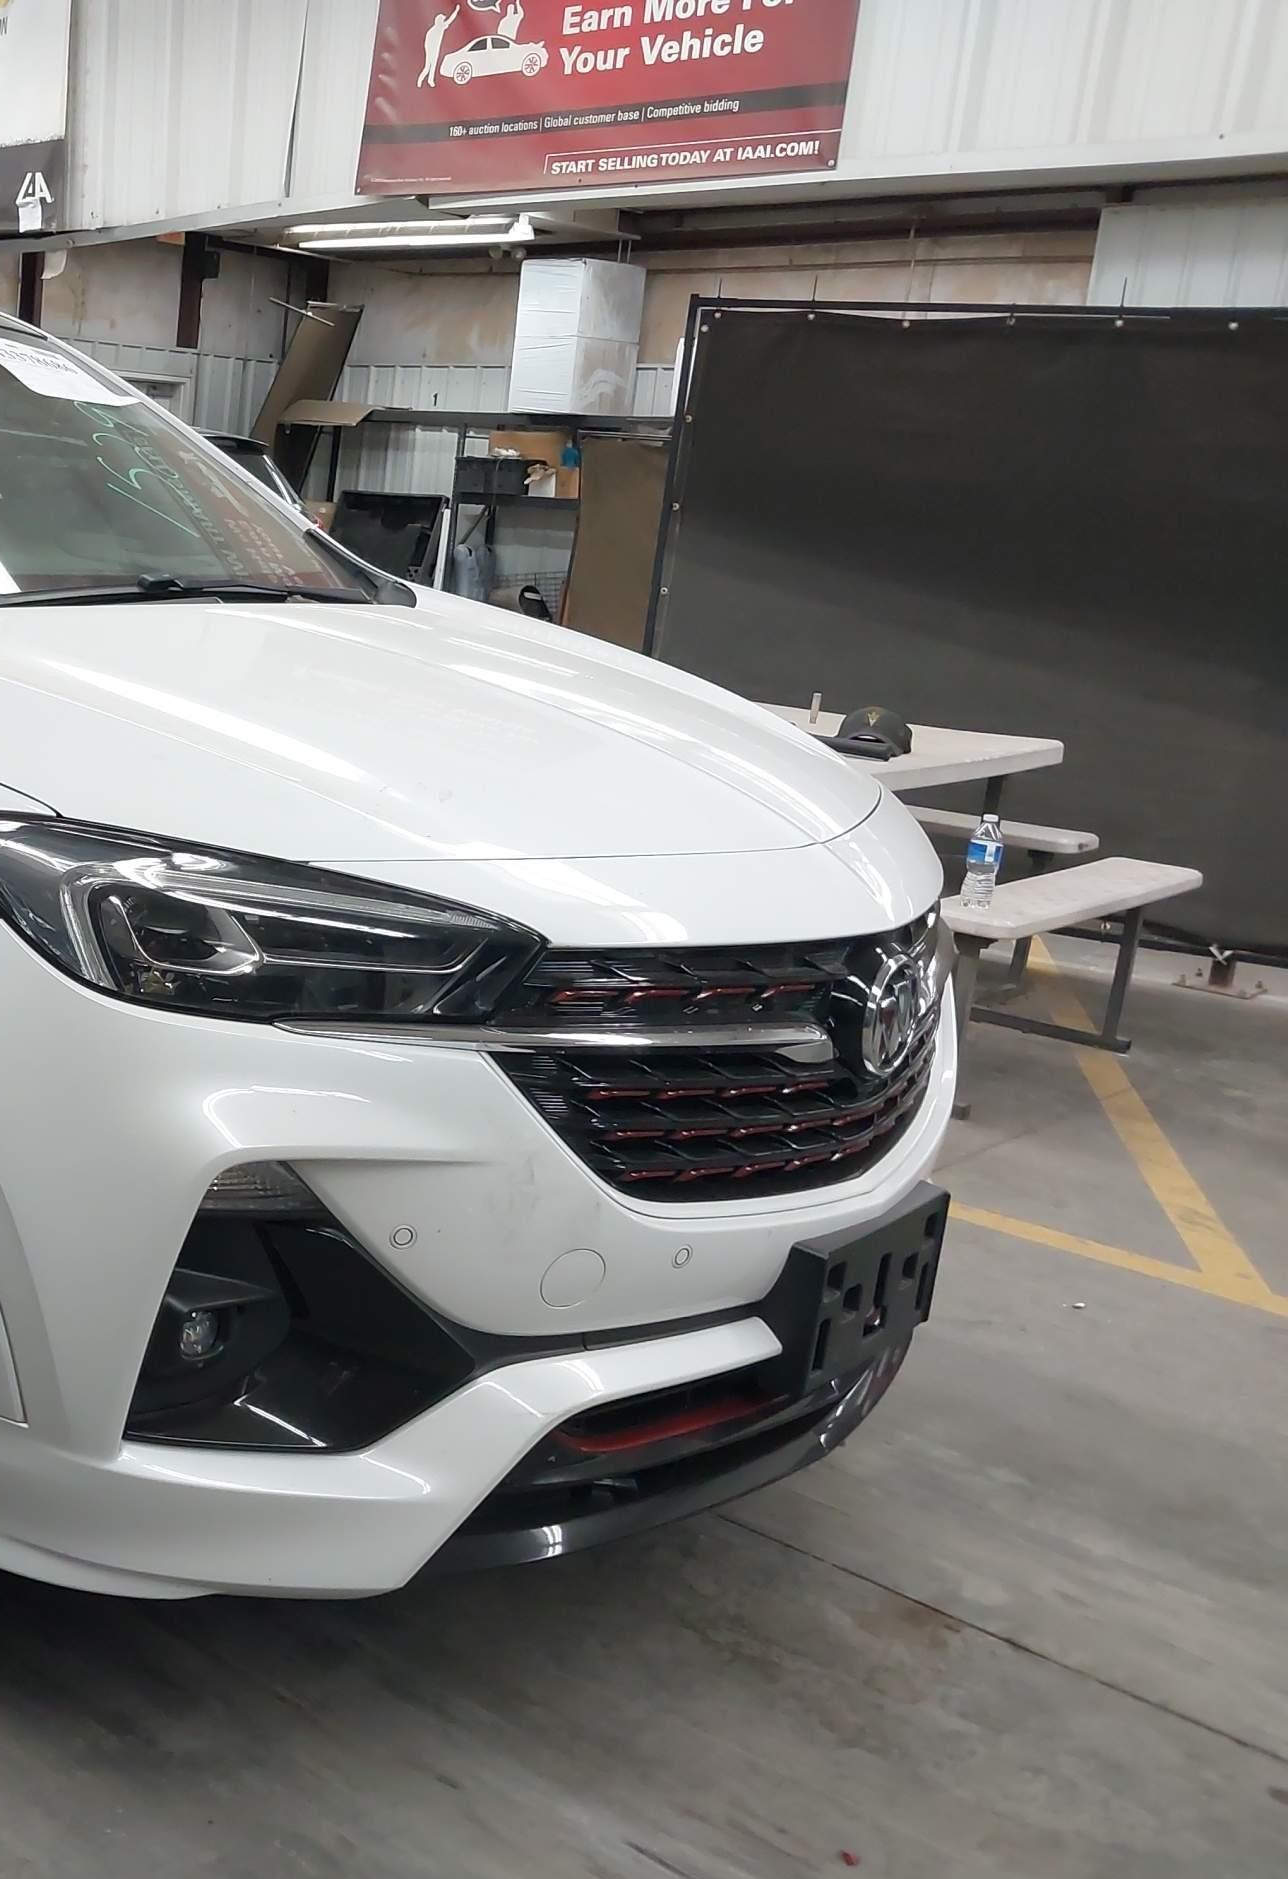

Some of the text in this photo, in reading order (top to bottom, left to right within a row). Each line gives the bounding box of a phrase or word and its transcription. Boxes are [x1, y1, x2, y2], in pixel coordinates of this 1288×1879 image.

[562, 0, 730, 36] Earn More
[560, 23, 764, 75] Your Vehicle
[468, 122, 500, 136] auction
[501, 119, 538, 133] locations
[544, 115, 572, 129] Global
[573, 112, 616, 126] customer
[617, 108, 640, 122] base
[646, 102, 702, 120] Competitive
[704, 98, 740, 113] bidding
[550, 140, 820, 175] START SELLING TODAY AT IAAI.COM!
